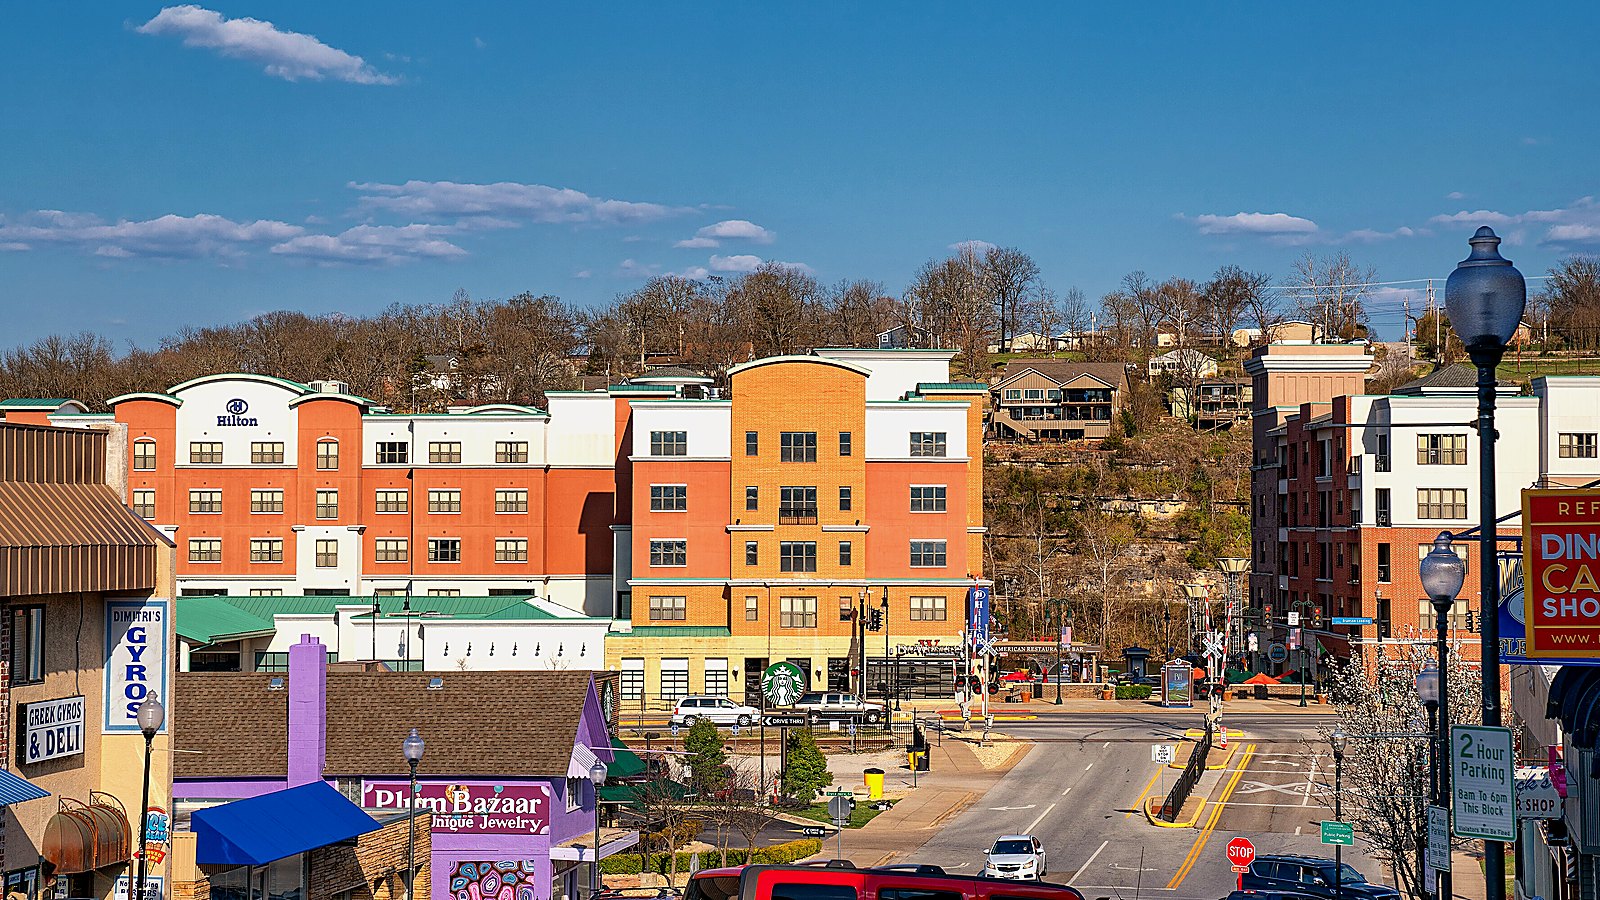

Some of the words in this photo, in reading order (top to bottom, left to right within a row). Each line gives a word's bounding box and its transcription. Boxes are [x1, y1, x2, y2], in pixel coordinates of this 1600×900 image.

[216, 414, 258, 427] Hilton
[1541, 533, 1600, 560] DIN
[113, 610, 161, 622] DIMITRI'S
[29, 705, 56, 727] GREEK
[57, 702, 82, 721] GYROS
[29, 731, 41, 760] &
[45, 725, 81, 757] DELI
[1460, 733, 1474, 759] 2
[1477, 743, 1505, 761] Hour
[1461, 761, 1505, 786] Parking
[452, 790, 542, 815] Bazaar
[1458, 788, 1476, 801] 8am
[1478, 790, 1487, 801] To
[1490, 791, 1508, 804] 6pm
[1525, 798, 1555, 812] SHOP
[1463, 801, 1479, 814] This
[1482, 803, 1504, 816] Block
[479, 814, 544, 833] Jewelry
[1229, 845, 1254, 858] STOP
